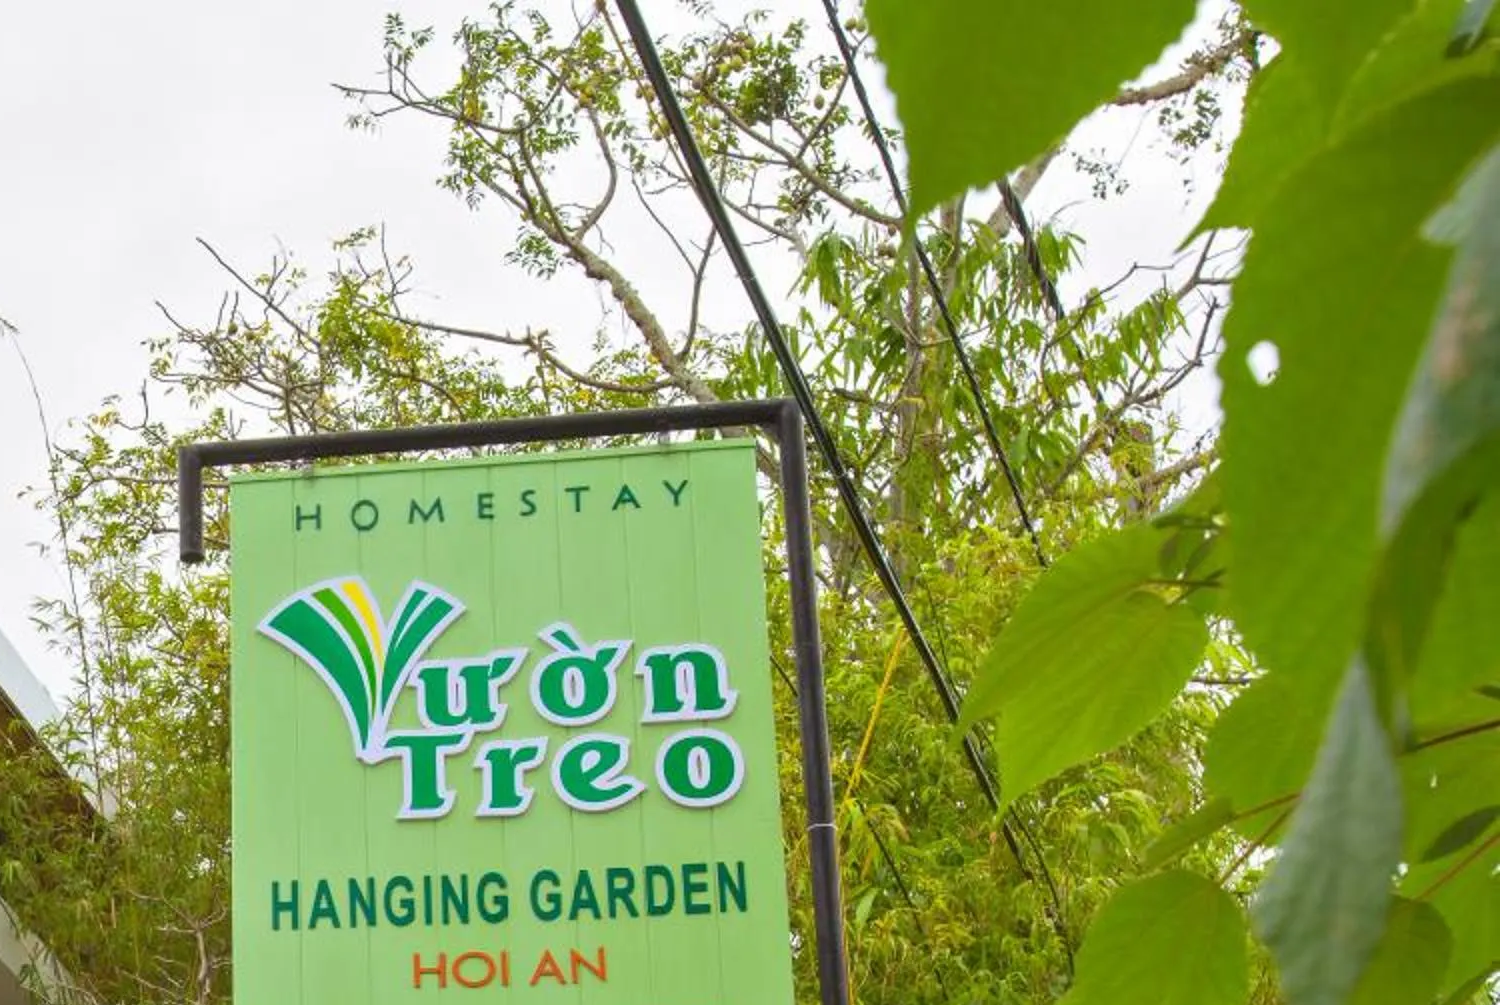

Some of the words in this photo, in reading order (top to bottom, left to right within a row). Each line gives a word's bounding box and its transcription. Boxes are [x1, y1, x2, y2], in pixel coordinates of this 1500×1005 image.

[294, 479, 690, 532] HOMESTAY
[384, 729, 745, 820] Treo
[271, 871, 509, 931] HANGING
[529, 860, 748, 922] GARDEN
[412, 950, 510, 989] HOI
[530, 946, 608, 986] AN
